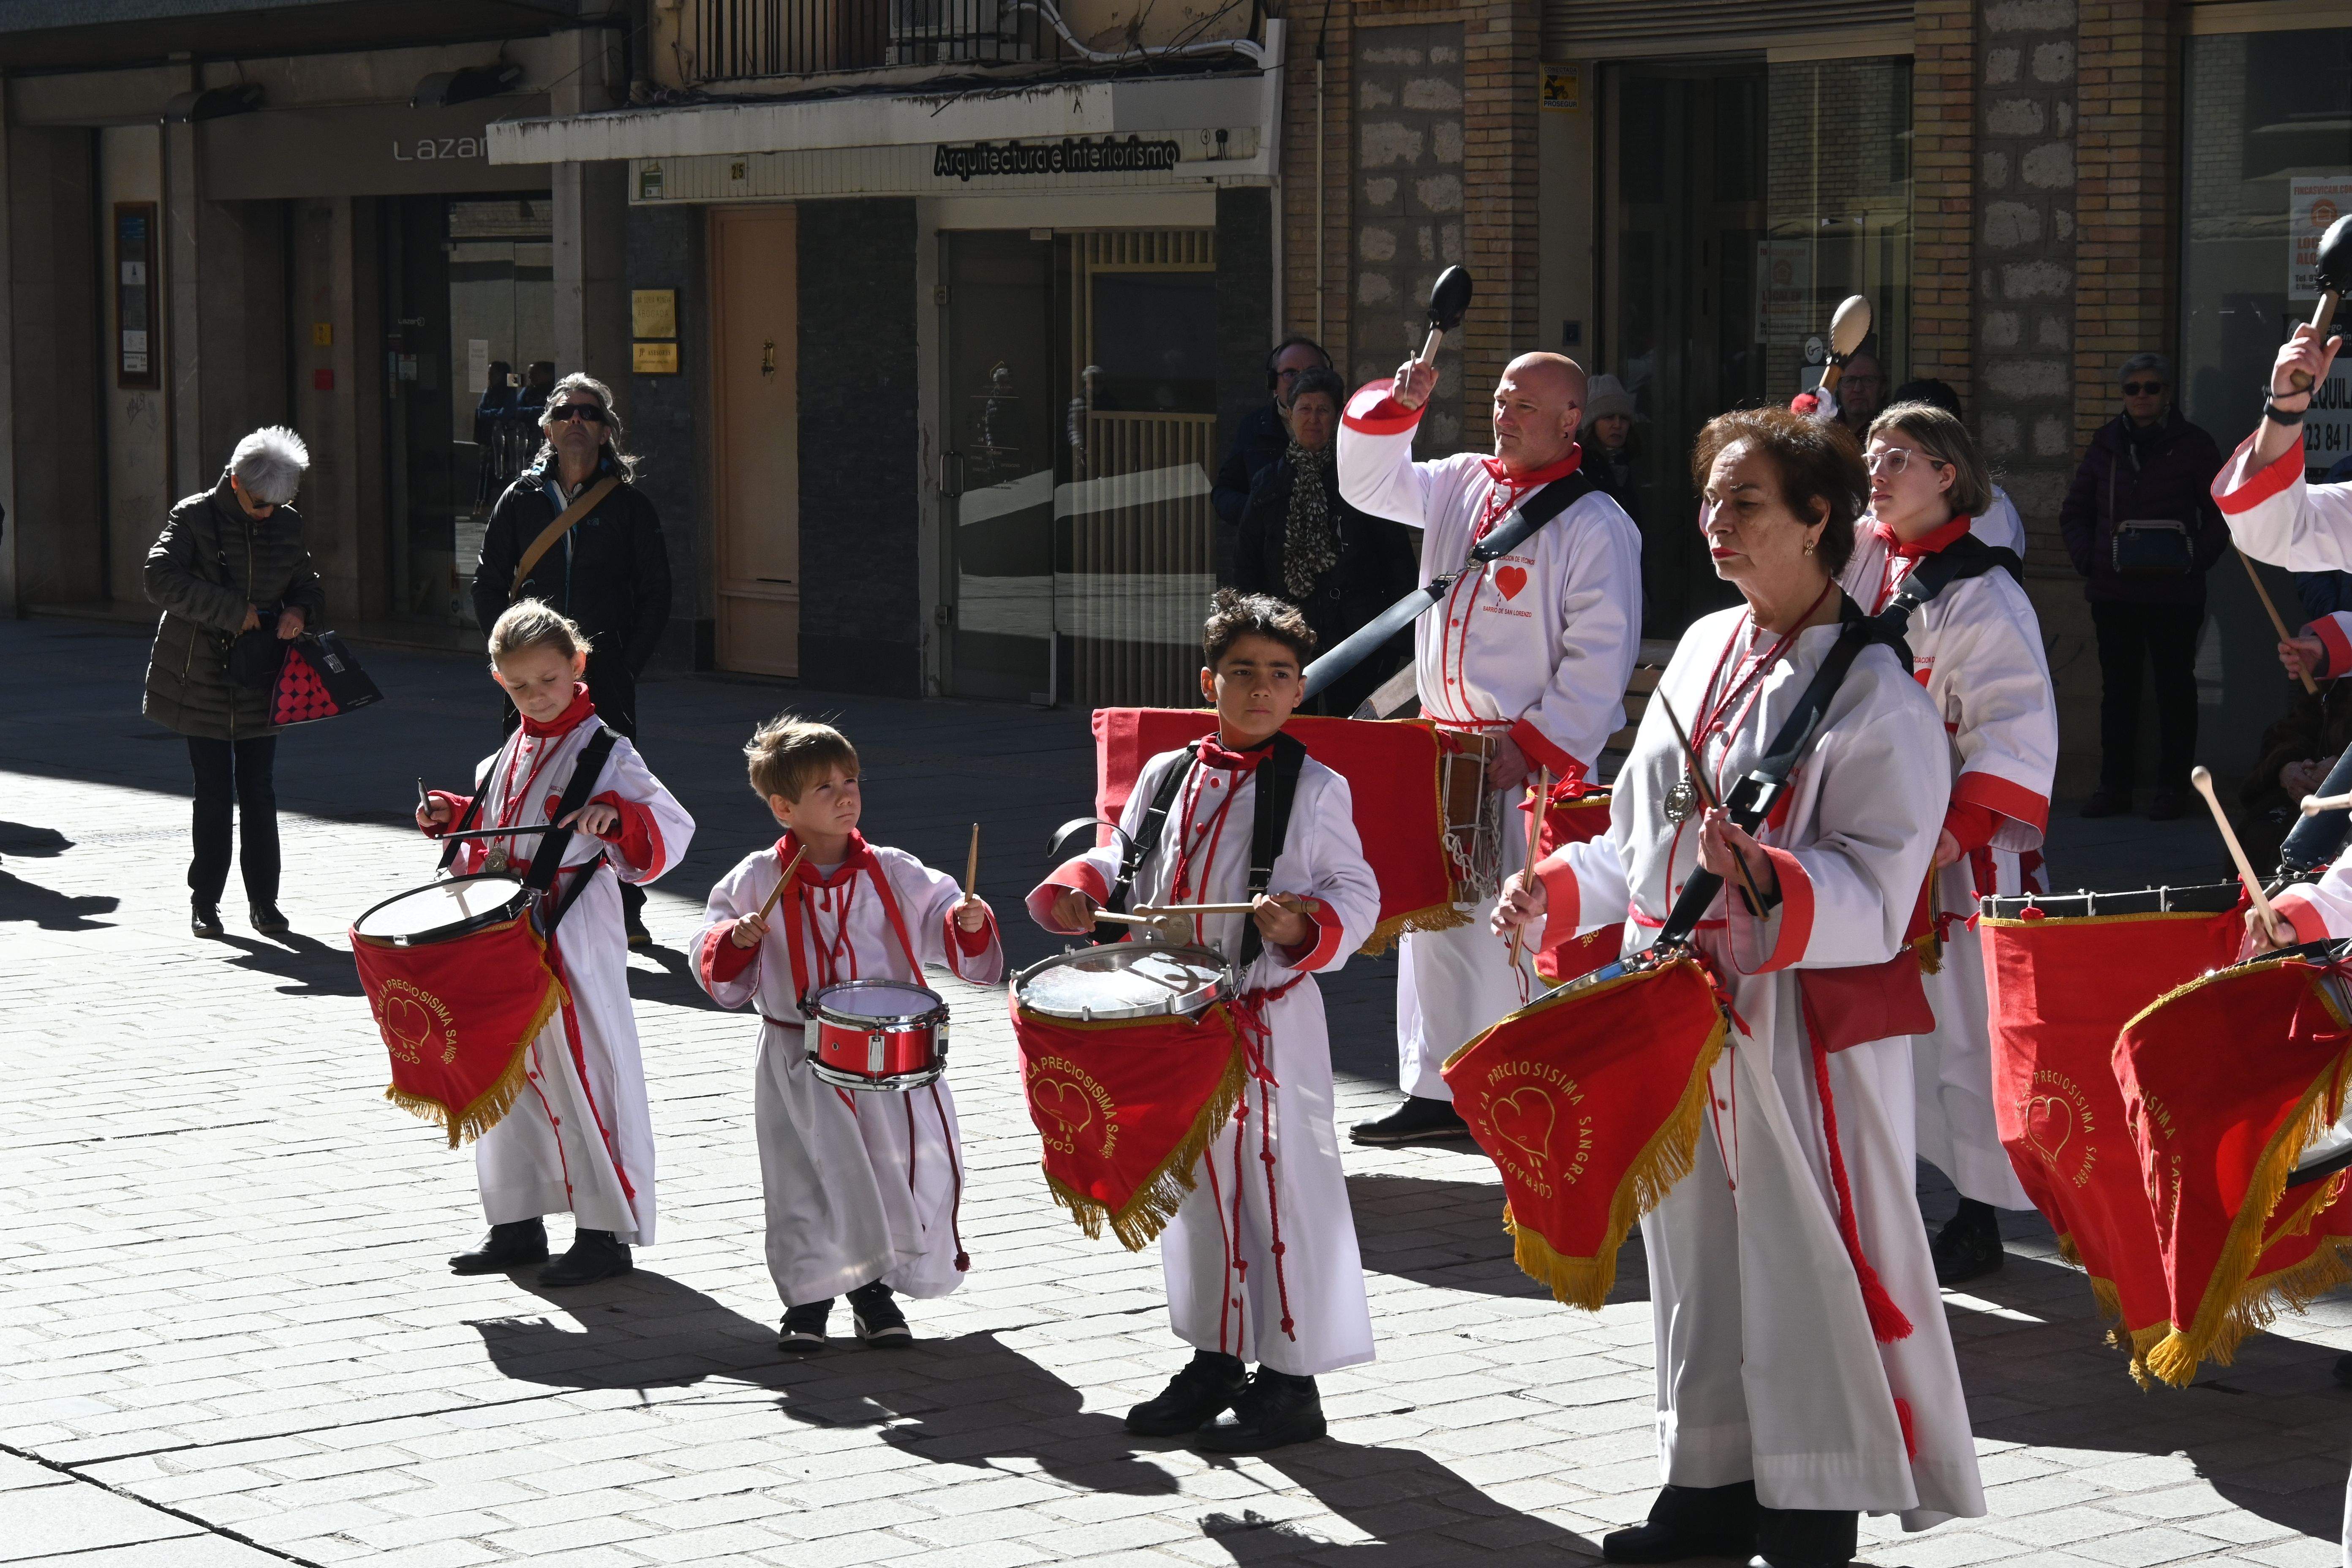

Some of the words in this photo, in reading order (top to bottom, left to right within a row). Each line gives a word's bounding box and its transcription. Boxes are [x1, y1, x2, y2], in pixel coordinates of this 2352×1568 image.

[394, 136, 487, 161] Lazar
[936, 144, 1047, 177] Arquitectura
[1051, 148, 1062, 168] e
[1065, 137, 1177, 168] Interiorismo
[732, 164, 743, 179] 25
[2298, 237, 2319, 248] LOC
[2308, 378, 2352, 410] QUIL
[2326, 423, 2341, 451] 84
[1521, 557, 1535, 565] VECINOS
[380, 984, 389, 999] LA
[387, 979, 453, 1027] PRECIOSISIMA
[1026, 1062, 1040, 1079] LA
[1040, 1056, 1117, 1120] PRECIOSISIMA
[1480, 1091, 1489, 1111] LA
[1487, 1061, 1584, 1106] PRECIOSISIMA
[2034, 1070, 2095, 1133] PRECIOSISIMA
[1564, 1116, 1593, 1184] SANGRE
[1497, 1149, 1552, 1198] COFRADIA
